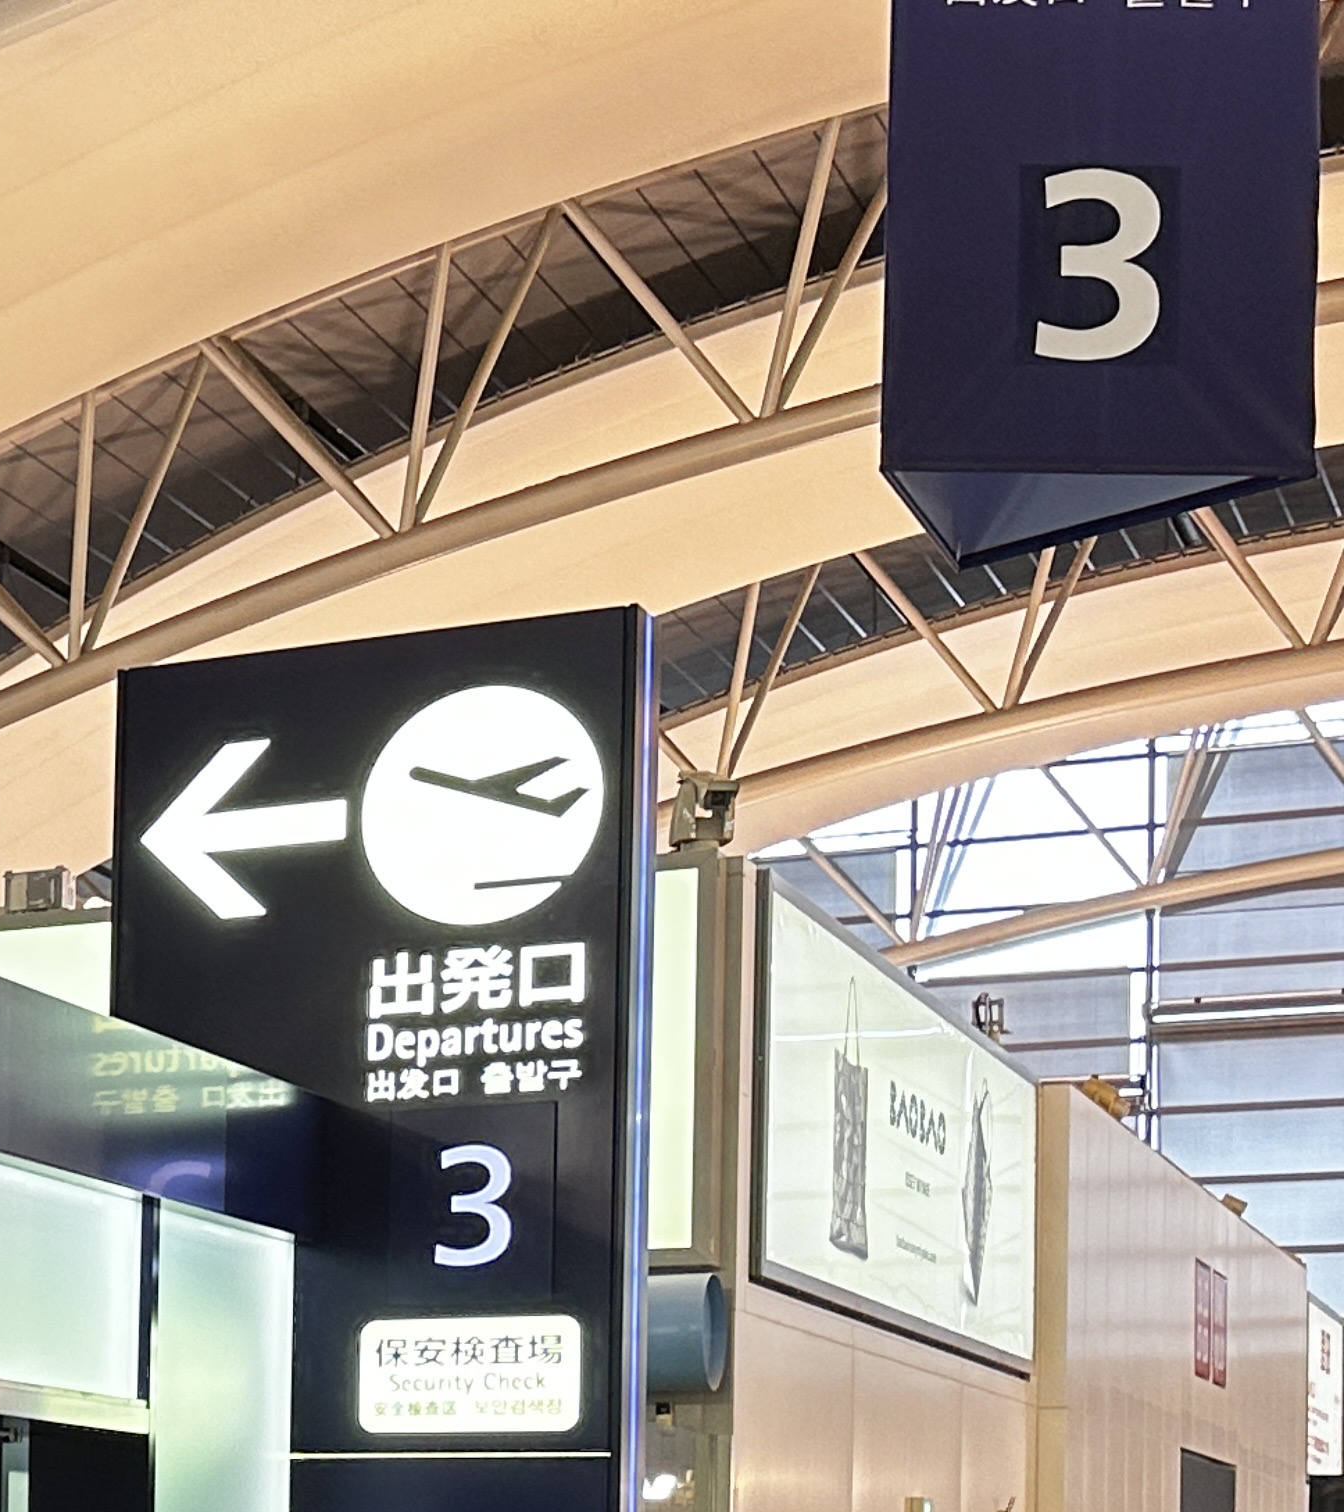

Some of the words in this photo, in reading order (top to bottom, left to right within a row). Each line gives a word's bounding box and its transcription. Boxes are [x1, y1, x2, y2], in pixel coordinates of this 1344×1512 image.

[1034, 168, 1161, 361] 3
[368, 942, 585, 1019] 出発口
[367, 1017, 584, 1067] Departures
[367, 1068, 459, 1102] 出发口
[481, 1058, 583, 1094] 출발구
[434, 1144, 511, 1266] 3
[376, 1335, 562, 1367] 保安検査場
[389, 1373, 473, 1395] Security
[484, 1371, 546, 1390] Check
